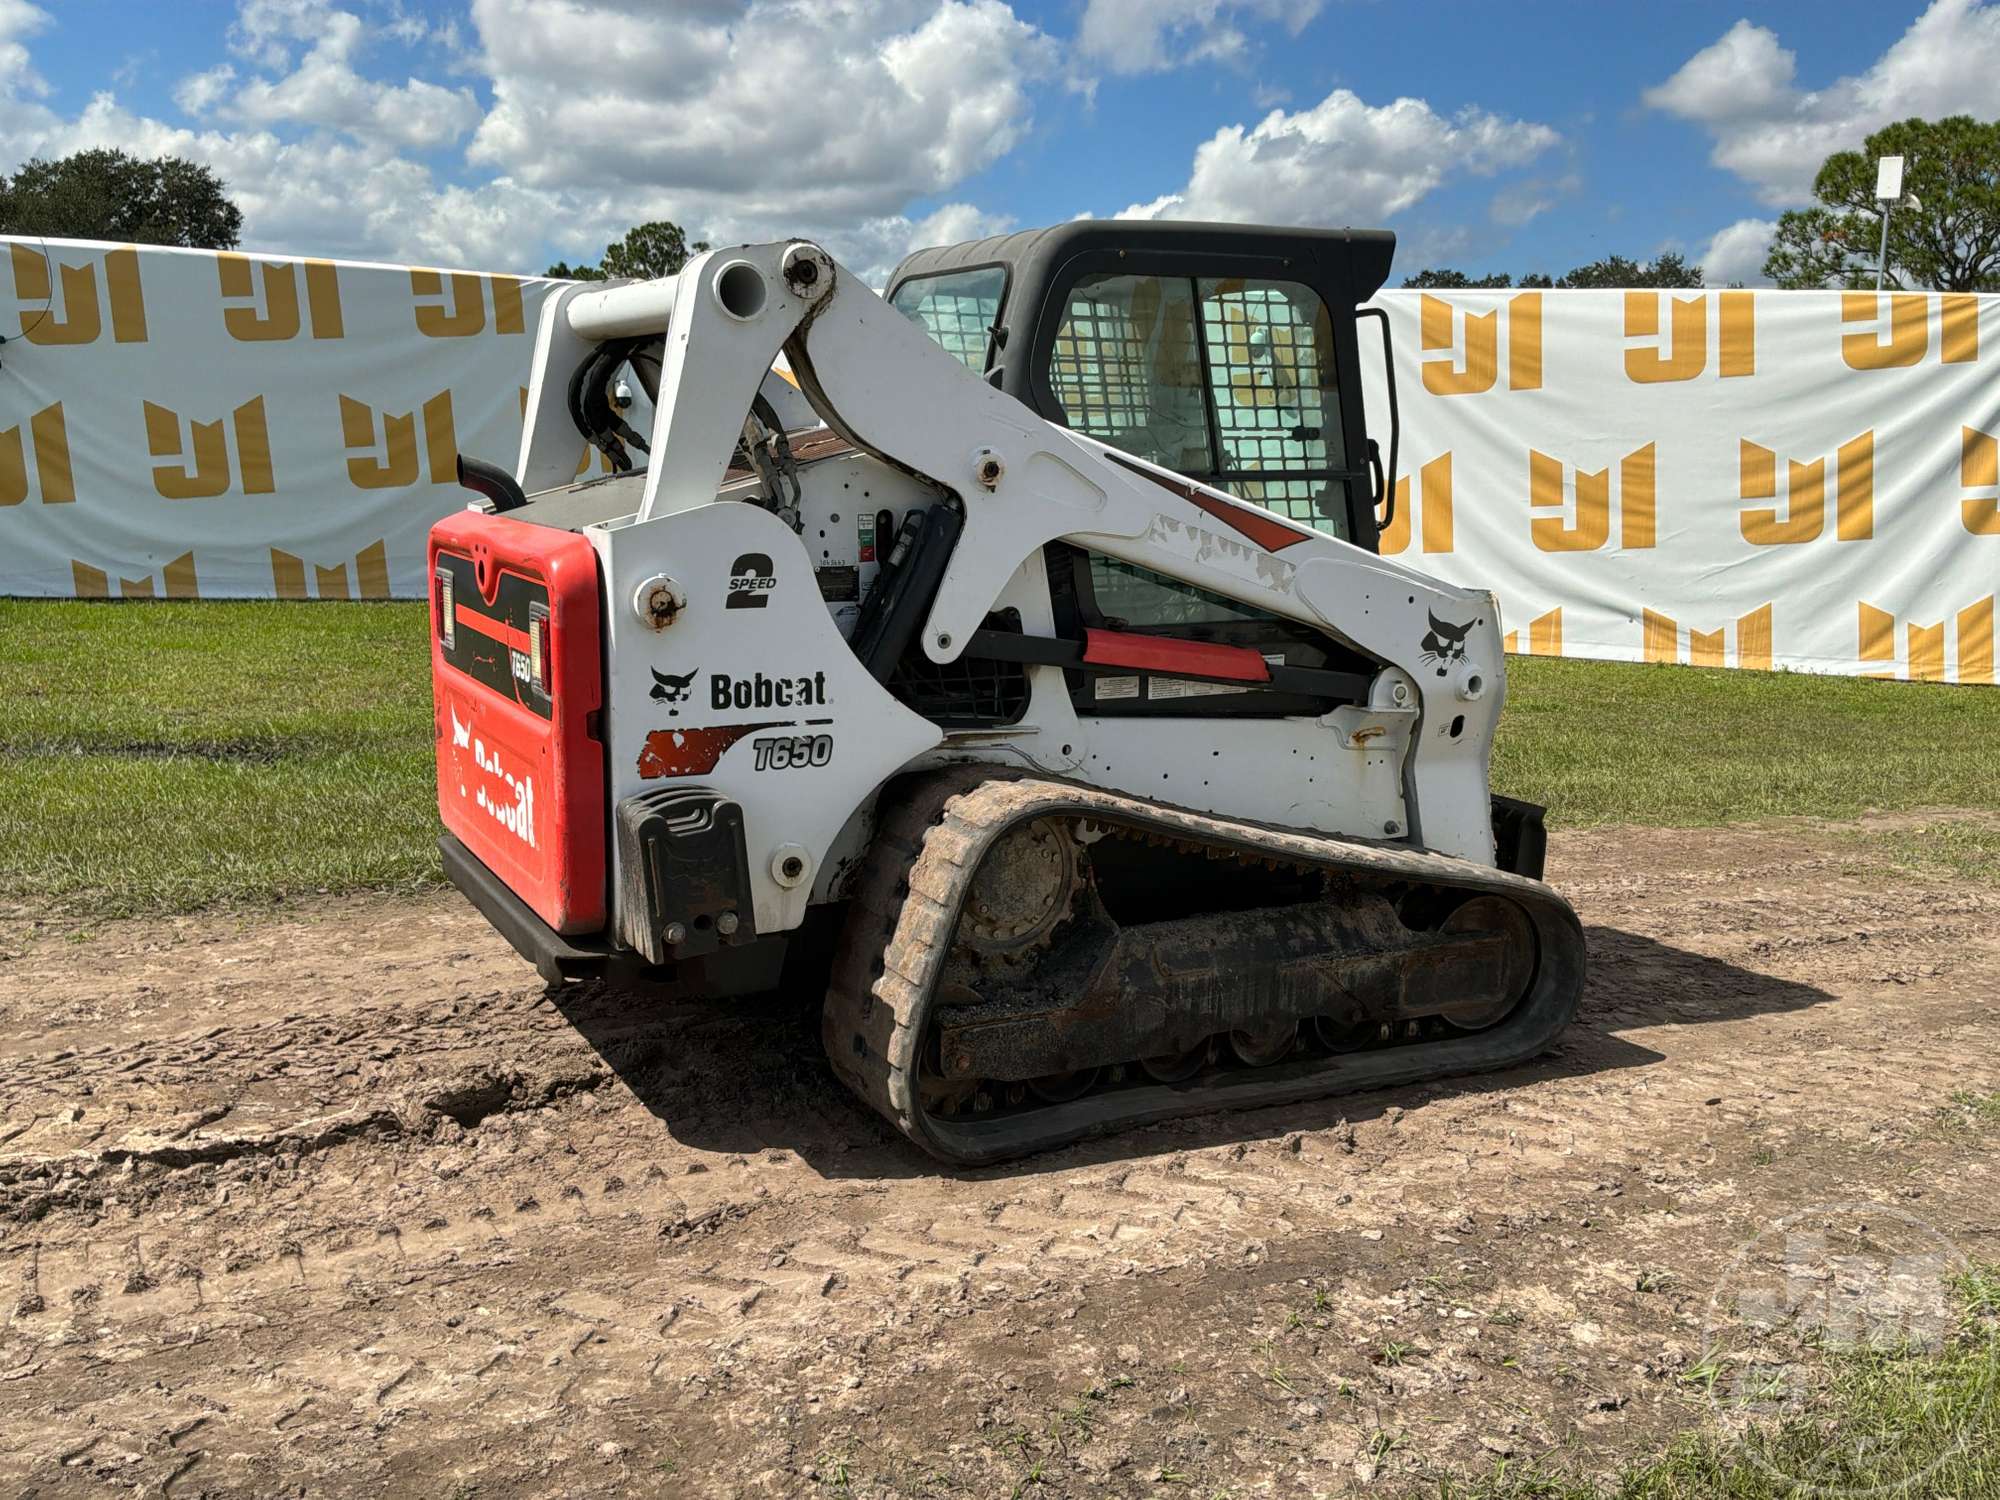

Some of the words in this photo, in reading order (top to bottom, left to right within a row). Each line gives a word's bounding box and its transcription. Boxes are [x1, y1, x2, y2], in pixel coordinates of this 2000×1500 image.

[728, 577, 777, 591] SPEED
[511, 650, 531, 683] T650
[710, 671, 826, 710] Bobcat
[753, 734, 834, 772] T650
